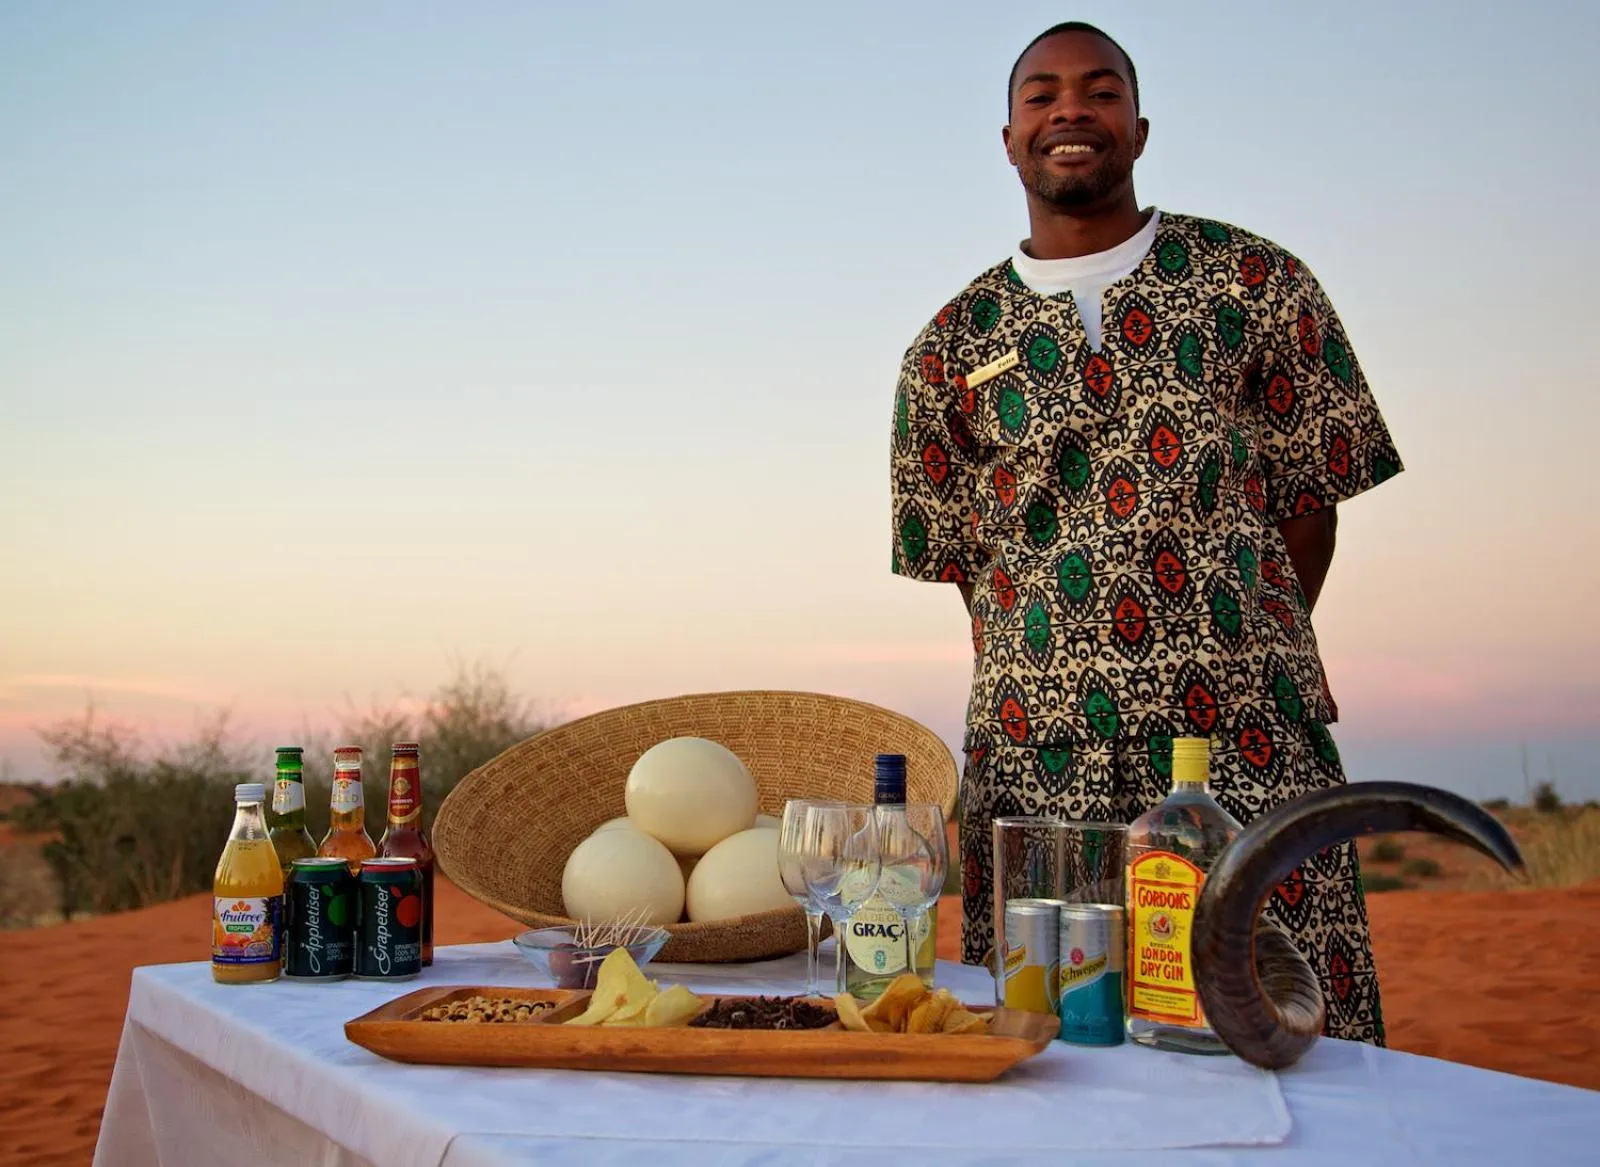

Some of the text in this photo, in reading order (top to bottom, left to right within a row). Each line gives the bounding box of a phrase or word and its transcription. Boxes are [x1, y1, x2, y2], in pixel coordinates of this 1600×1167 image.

[1138, 887, 1191, 909] GORDON'S
[301, 885, 323, 973] Appletiser
[370, 885, 392, 975] Grapetiser
[1141, 947, 1182, 963] LONDON
[1140, 961, 1184, 981] DRY GIN
